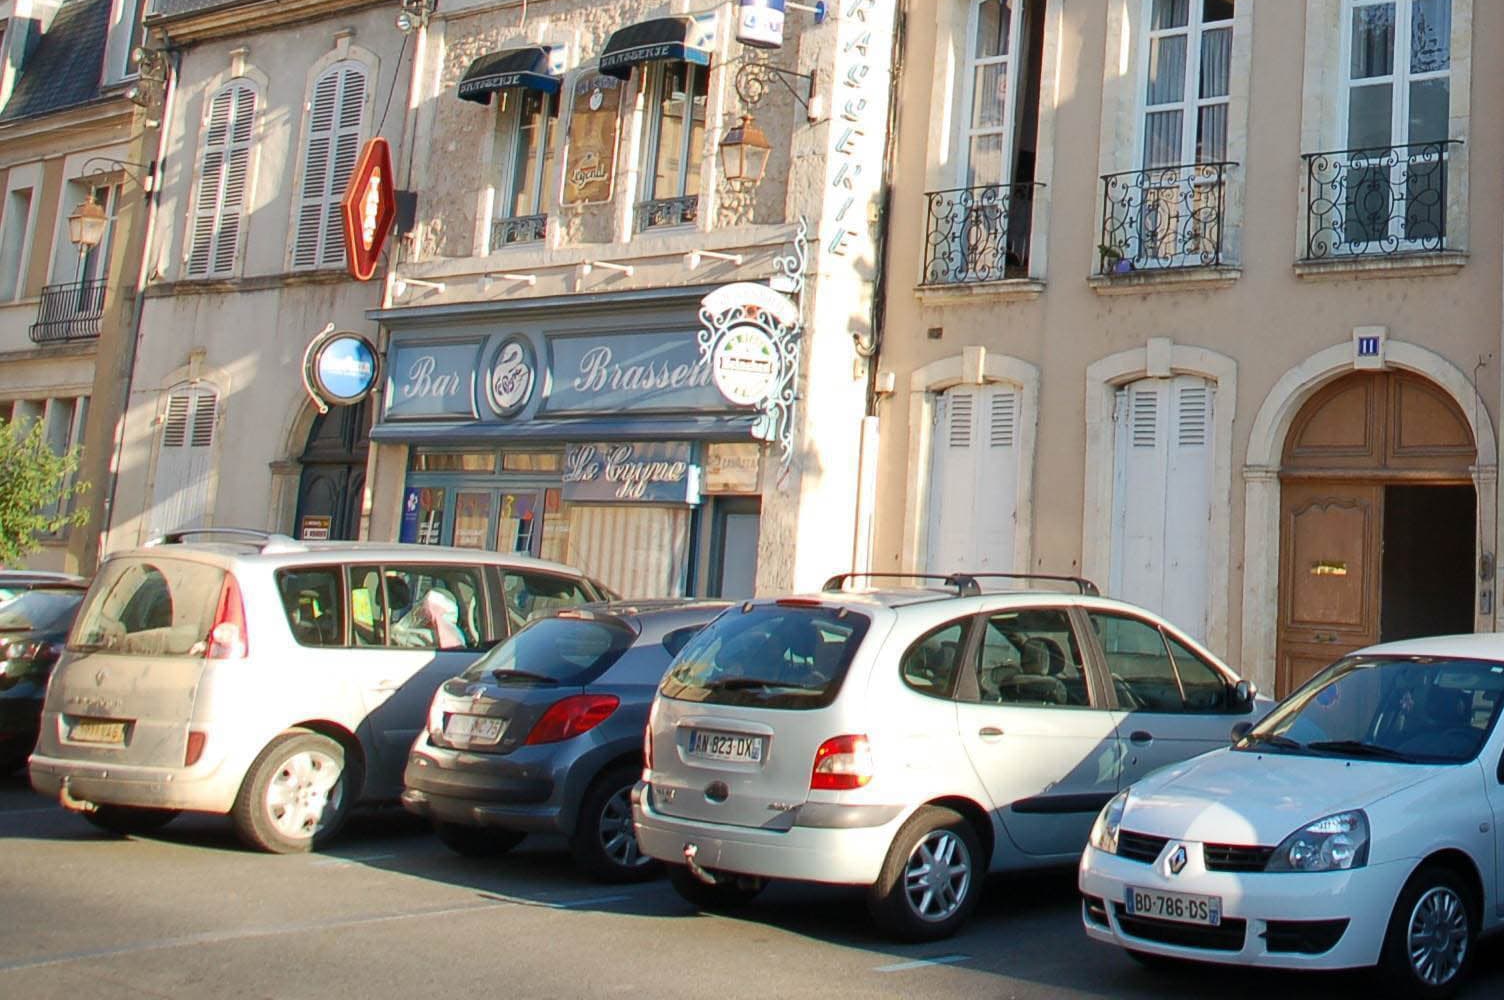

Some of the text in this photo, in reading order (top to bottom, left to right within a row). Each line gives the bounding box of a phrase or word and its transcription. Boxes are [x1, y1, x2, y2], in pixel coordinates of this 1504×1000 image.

[1362, 338, 1374, 354] 11
[404, 355, 462, 399] Bar
[563, 445, 600, 482] Le
[605, 444, 686, 498] Cygne
